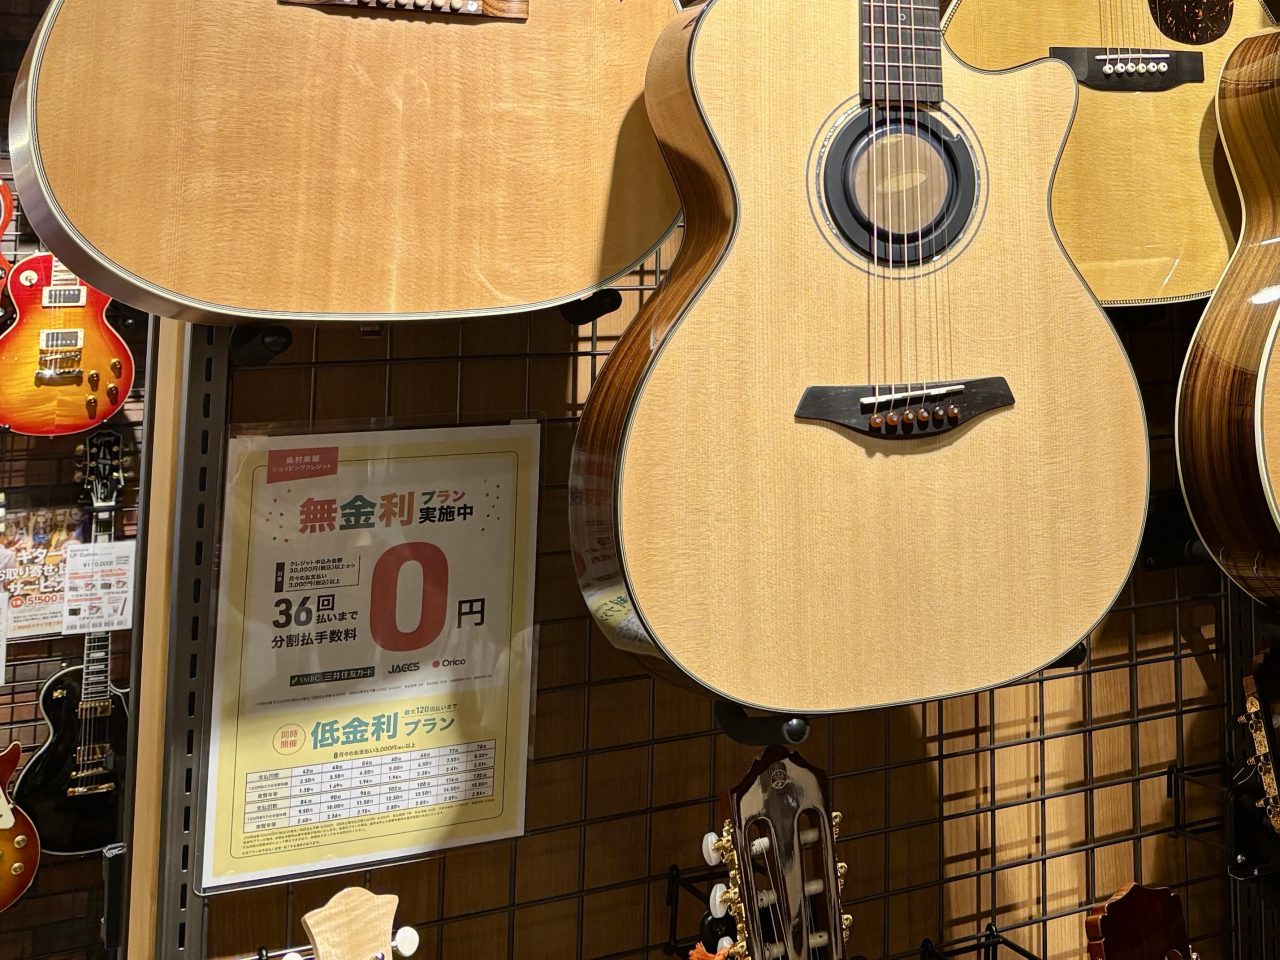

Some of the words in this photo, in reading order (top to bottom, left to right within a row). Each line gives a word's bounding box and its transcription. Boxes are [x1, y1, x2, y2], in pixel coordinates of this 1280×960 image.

[421, 490, 466, 505] プラン
[298, 493, 415, 534] 無金利
[418, 504, 474, 525] 実施中
[370, 542, 449, 652] 0
[457, 598, 486, 628] 円
[272, 597, 312, 629] 36
[316, 594, 335, 611] 回
[316, 610, 358, 624] 払いまで
[272, 628, 358, 649] 分割払手数料
[388, 662, 420, 674] JACCS
[442, 659, 466, 667] Orico
[324, 668, 374, 680] 三井住友カード
[311, 712, 398, 750] 低金利
[404, 717, 456, 736] プラン
